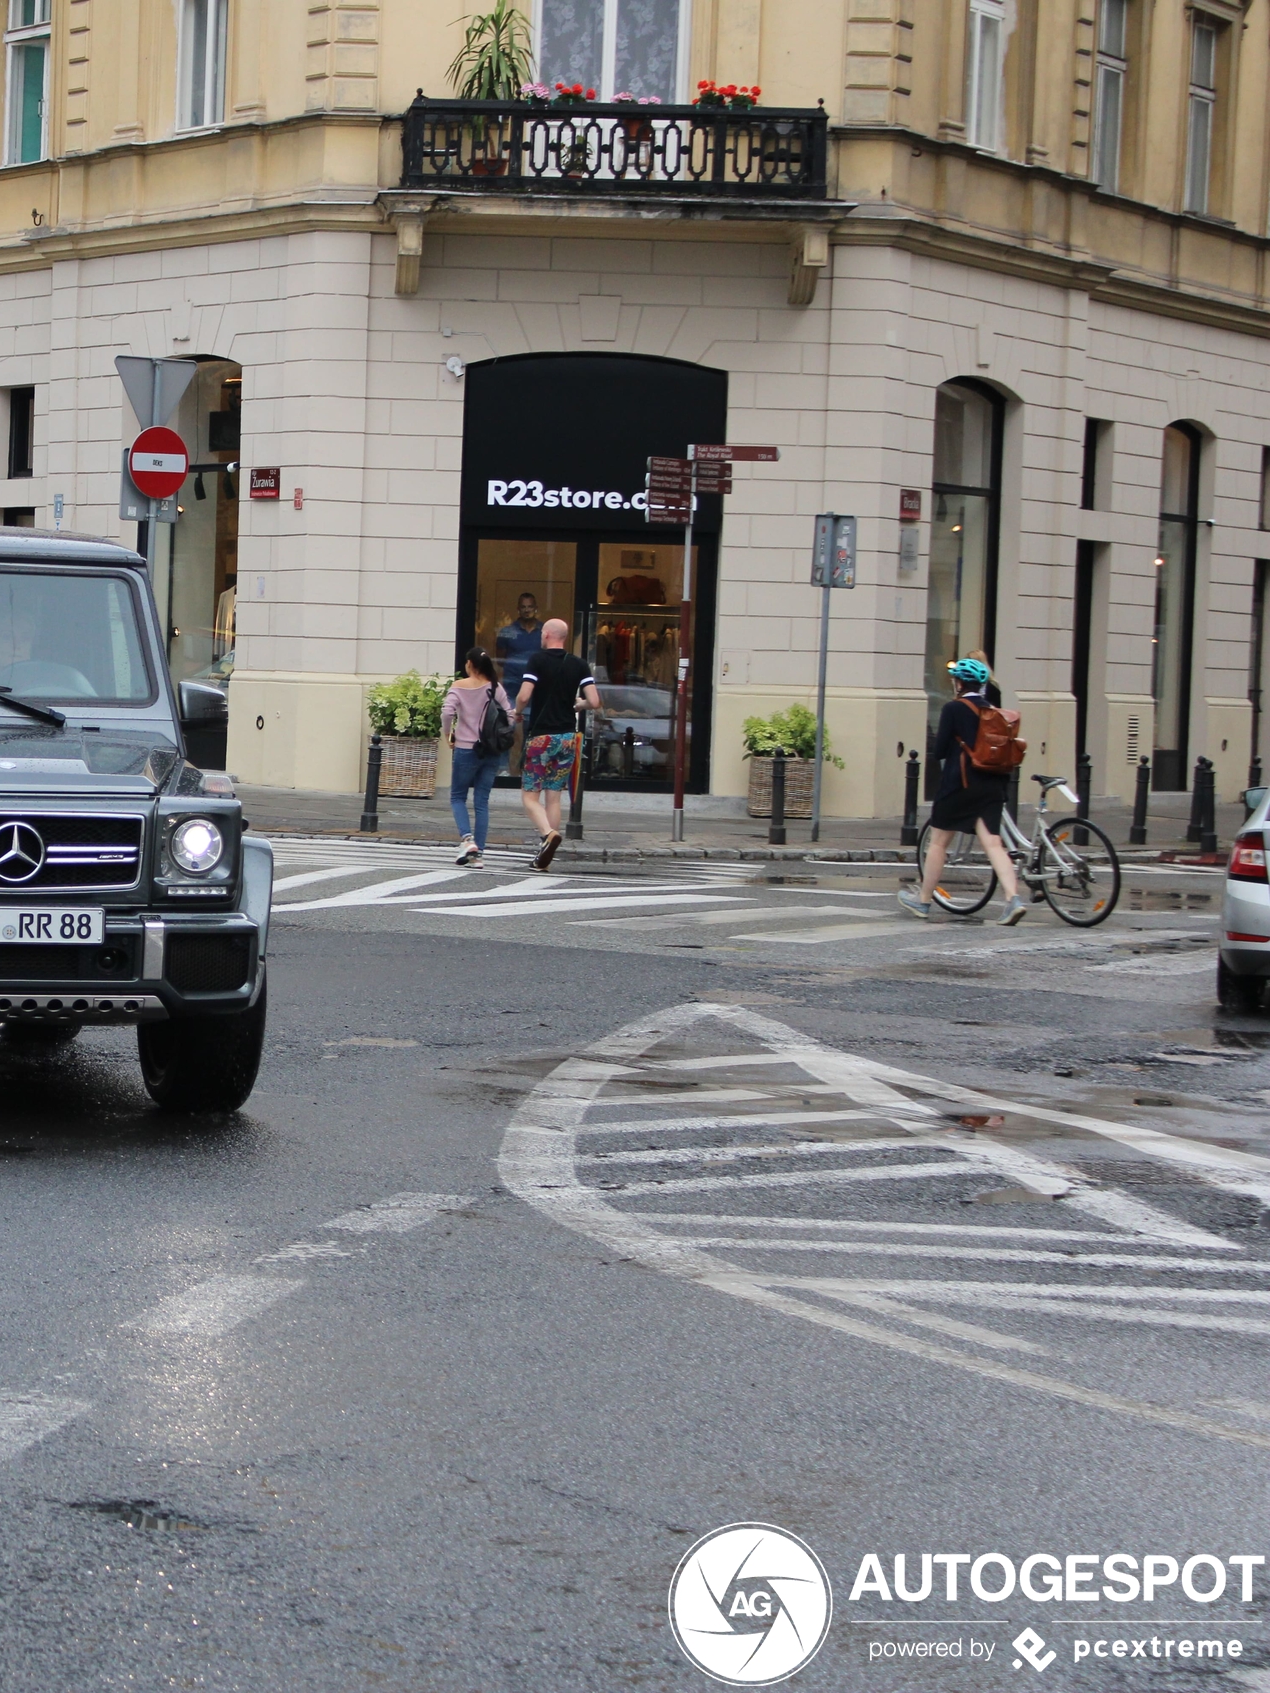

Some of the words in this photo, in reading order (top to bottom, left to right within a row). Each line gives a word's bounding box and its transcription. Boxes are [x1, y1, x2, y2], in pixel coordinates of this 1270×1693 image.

[487, 480, 697, 510] R23store.c
[18, 913, 52, 939] RR
[59, 913, 92, 940] 88
